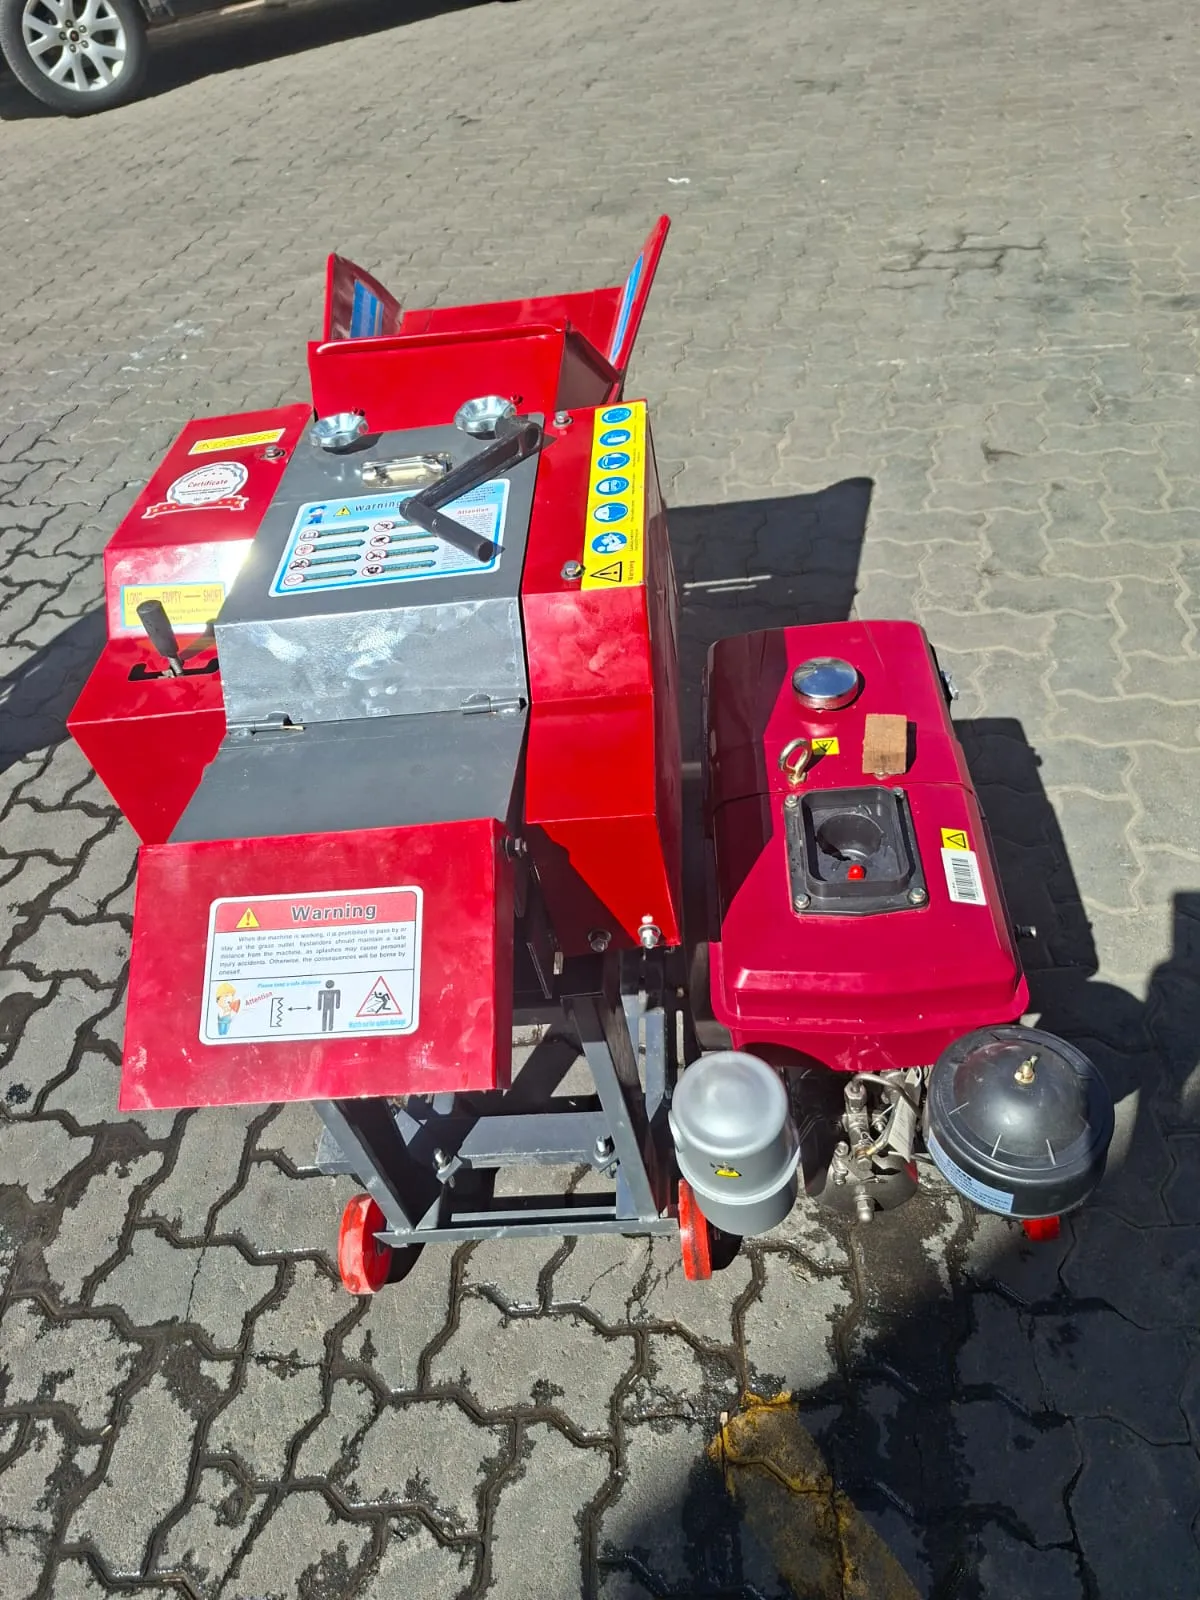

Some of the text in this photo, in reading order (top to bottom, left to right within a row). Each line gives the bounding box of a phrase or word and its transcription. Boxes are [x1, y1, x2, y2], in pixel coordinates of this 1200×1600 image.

[187, 480, 228, 488] Certificate
[291, 903, 377, 921] Warning
[245, 991, 273, 1006] Attention
